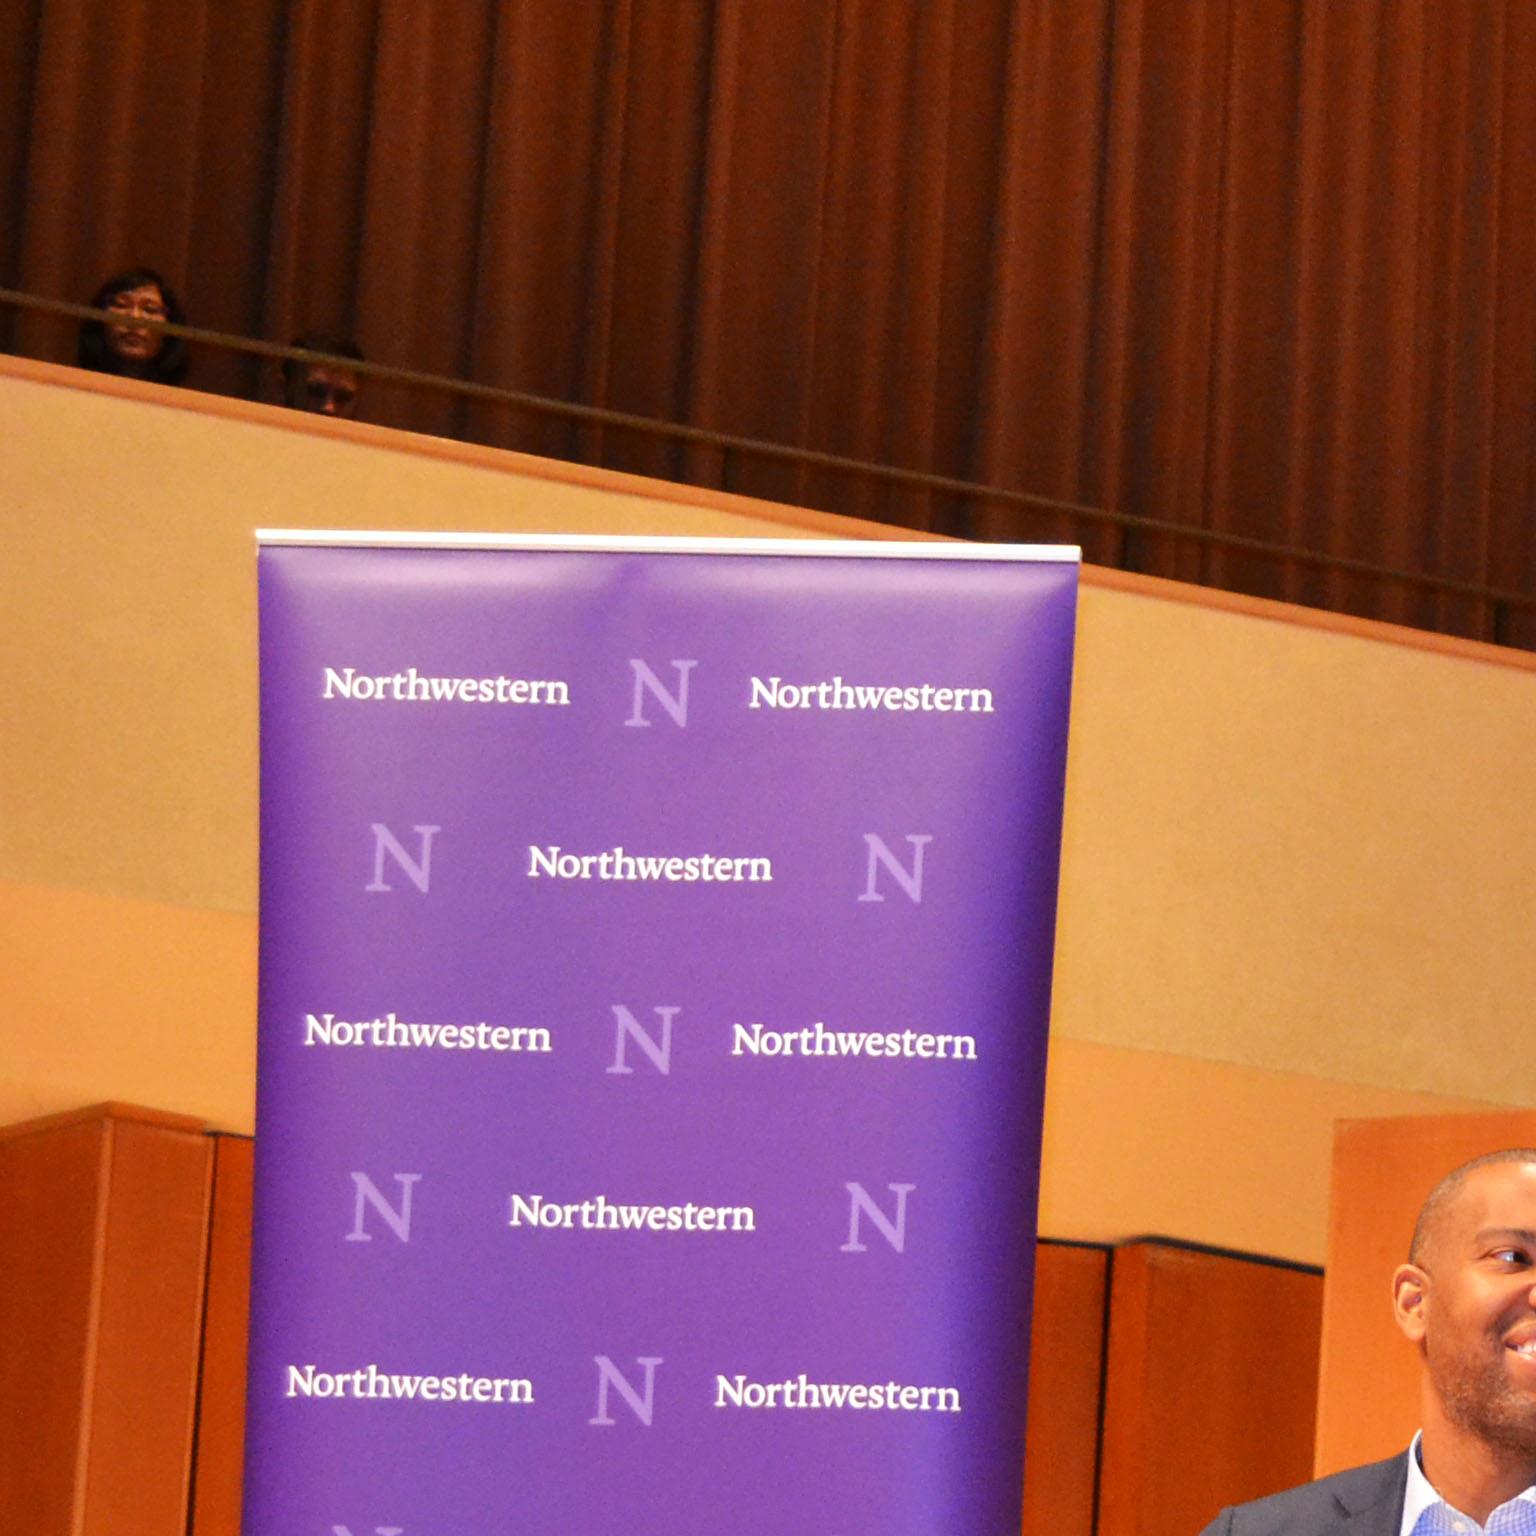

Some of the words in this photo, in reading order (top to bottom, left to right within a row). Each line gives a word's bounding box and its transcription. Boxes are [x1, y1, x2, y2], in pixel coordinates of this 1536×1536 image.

[321, 666, 571, 706] Northwestern
[624, 659, 697, 727] N
[747, 675, 995, 713] Northwestern
[365, 823, 441, 893] N
[526, 844, 774, 883] Northwestern
[857, 833, 933, 903] N
[303, 1012, 553, 1053] Northwestern
[606, 1004, 681, 1075] N
[730, 1021, 978, 1061] Northwestern
[345, 1172, 422, 1243] N
[507, 1193, 757, 1232] Northwestern
[840, 1182, 916, 1253] N
[283, 1363, 536, 1405] Northwestern
[589, 1355, 664, 1426] N
[712, 1373, 962, 1414] Northwestern
